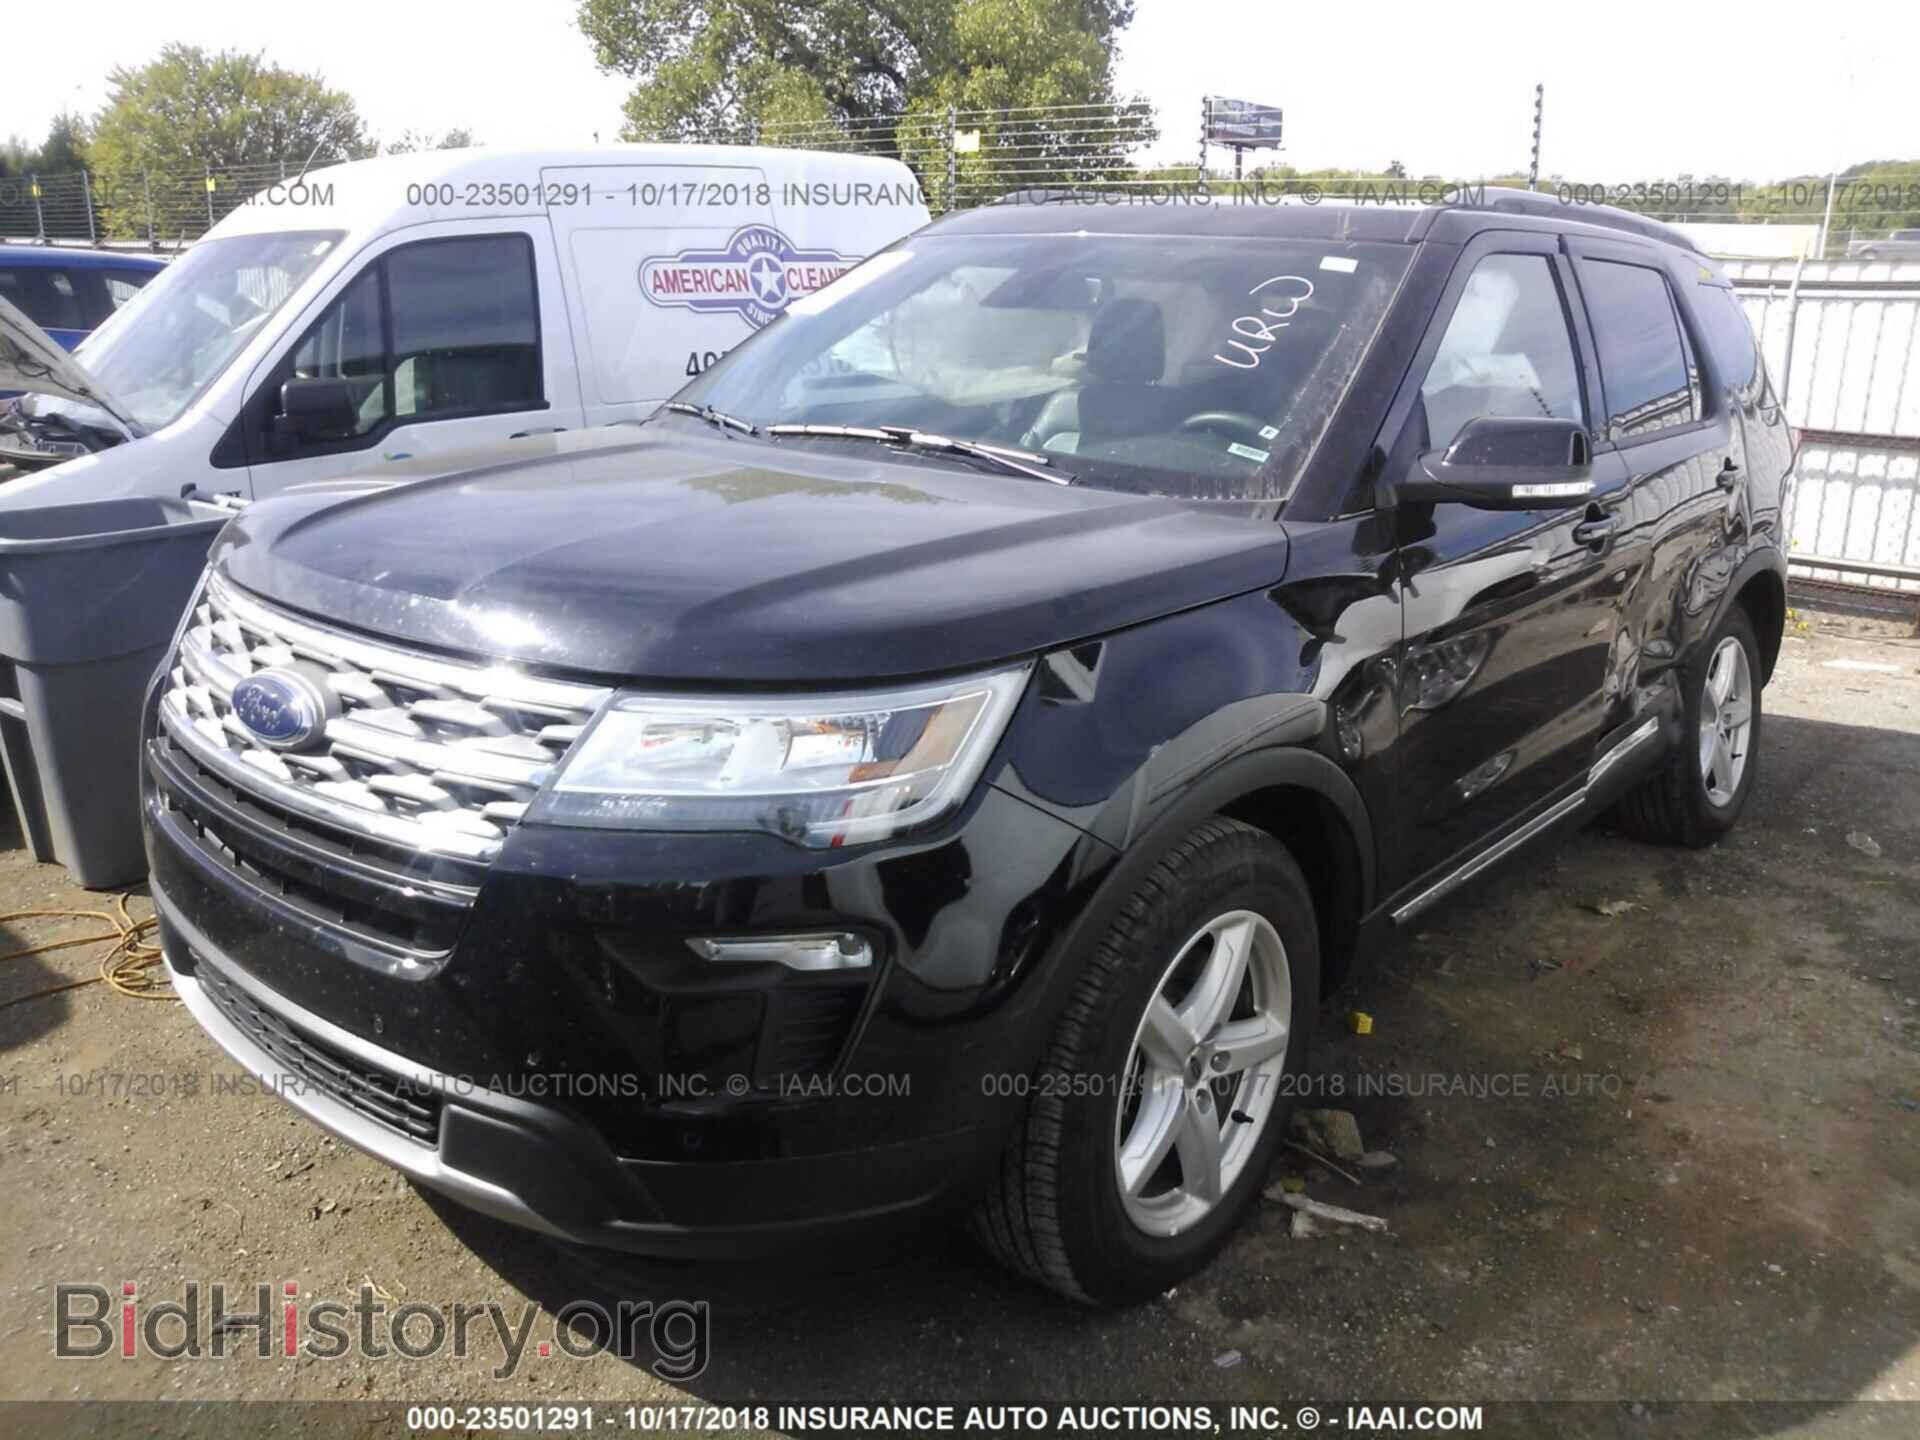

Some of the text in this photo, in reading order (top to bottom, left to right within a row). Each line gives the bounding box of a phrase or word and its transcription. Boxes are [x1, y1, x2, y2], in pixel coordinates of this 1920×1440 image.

[736, 234, 785, 256] QUALITY
[652, 267, 849, 294] AMERICAN CLEAN
[746, 302, 777, 325] SINC
[686, 351, 730, 377] 40
